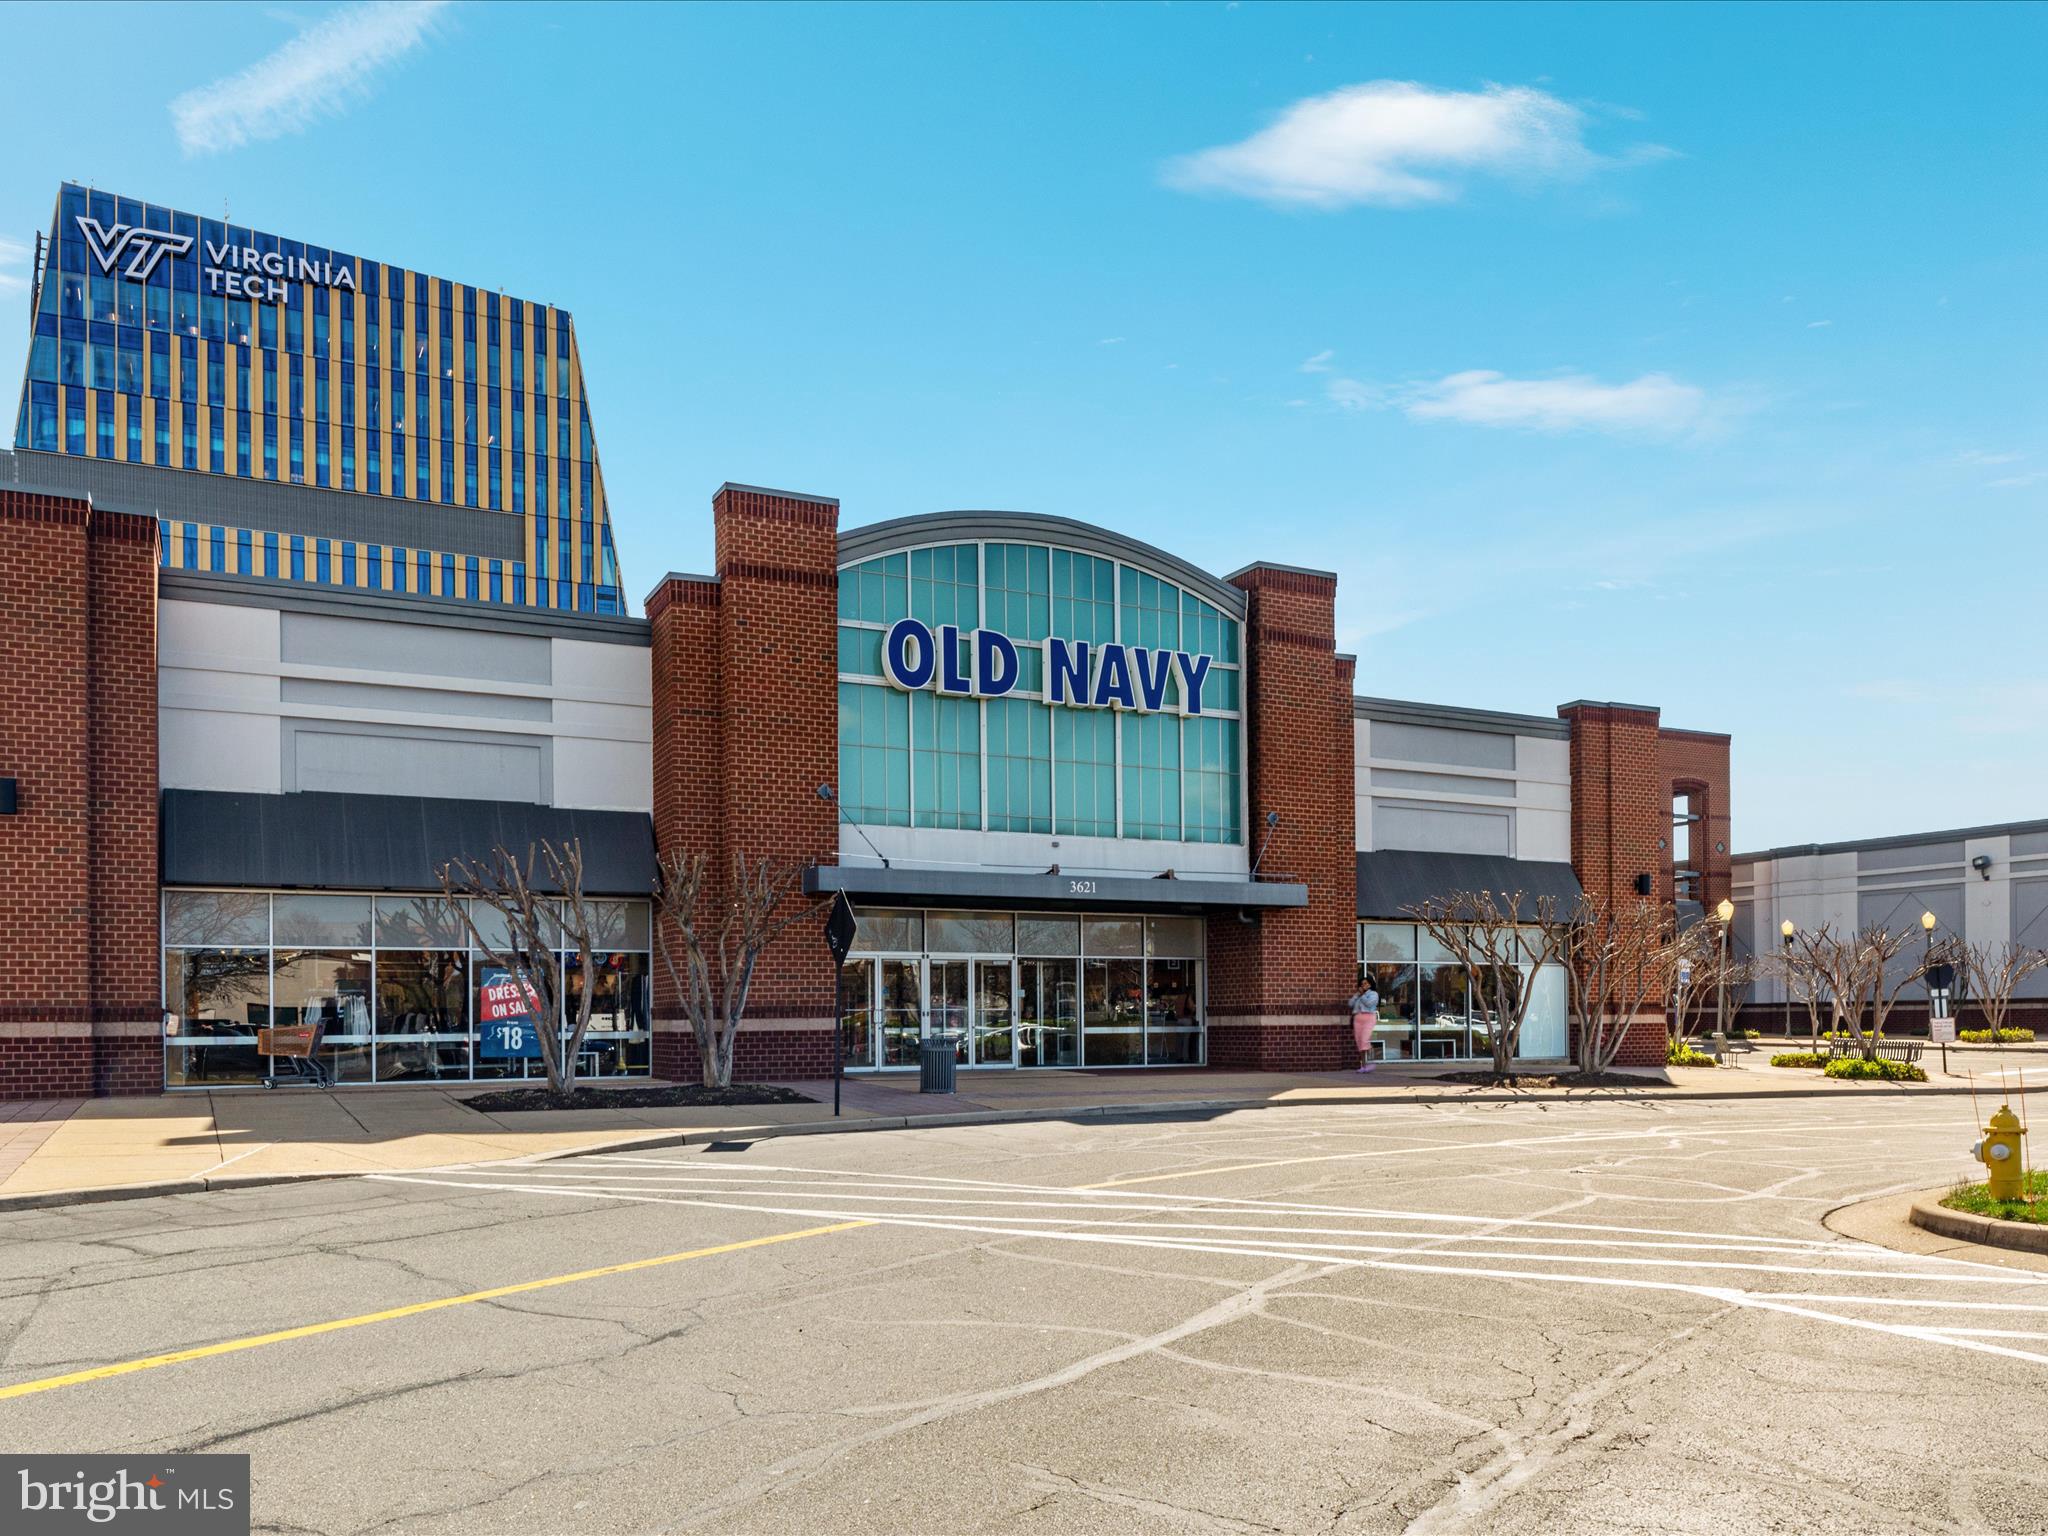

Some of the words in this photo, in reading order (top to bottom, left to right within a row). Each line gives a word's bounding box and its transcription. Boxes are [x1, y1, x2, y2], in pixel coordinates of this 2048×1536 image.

[75, 215, 194, 279] VT
[205, 240, 356, 290] VIRGINIA
[204, 267, 289, 304] TECH
[881, 618, 1020, 698] OLD
[1042, 637, 1214, 718] NAVY
[1069, 880, 1096, 894] 3621
[492, 1004, 508, 1018] ON
[509, 1000, 531, 1015] SAL
[496, 1026, 523, 1050] $18
